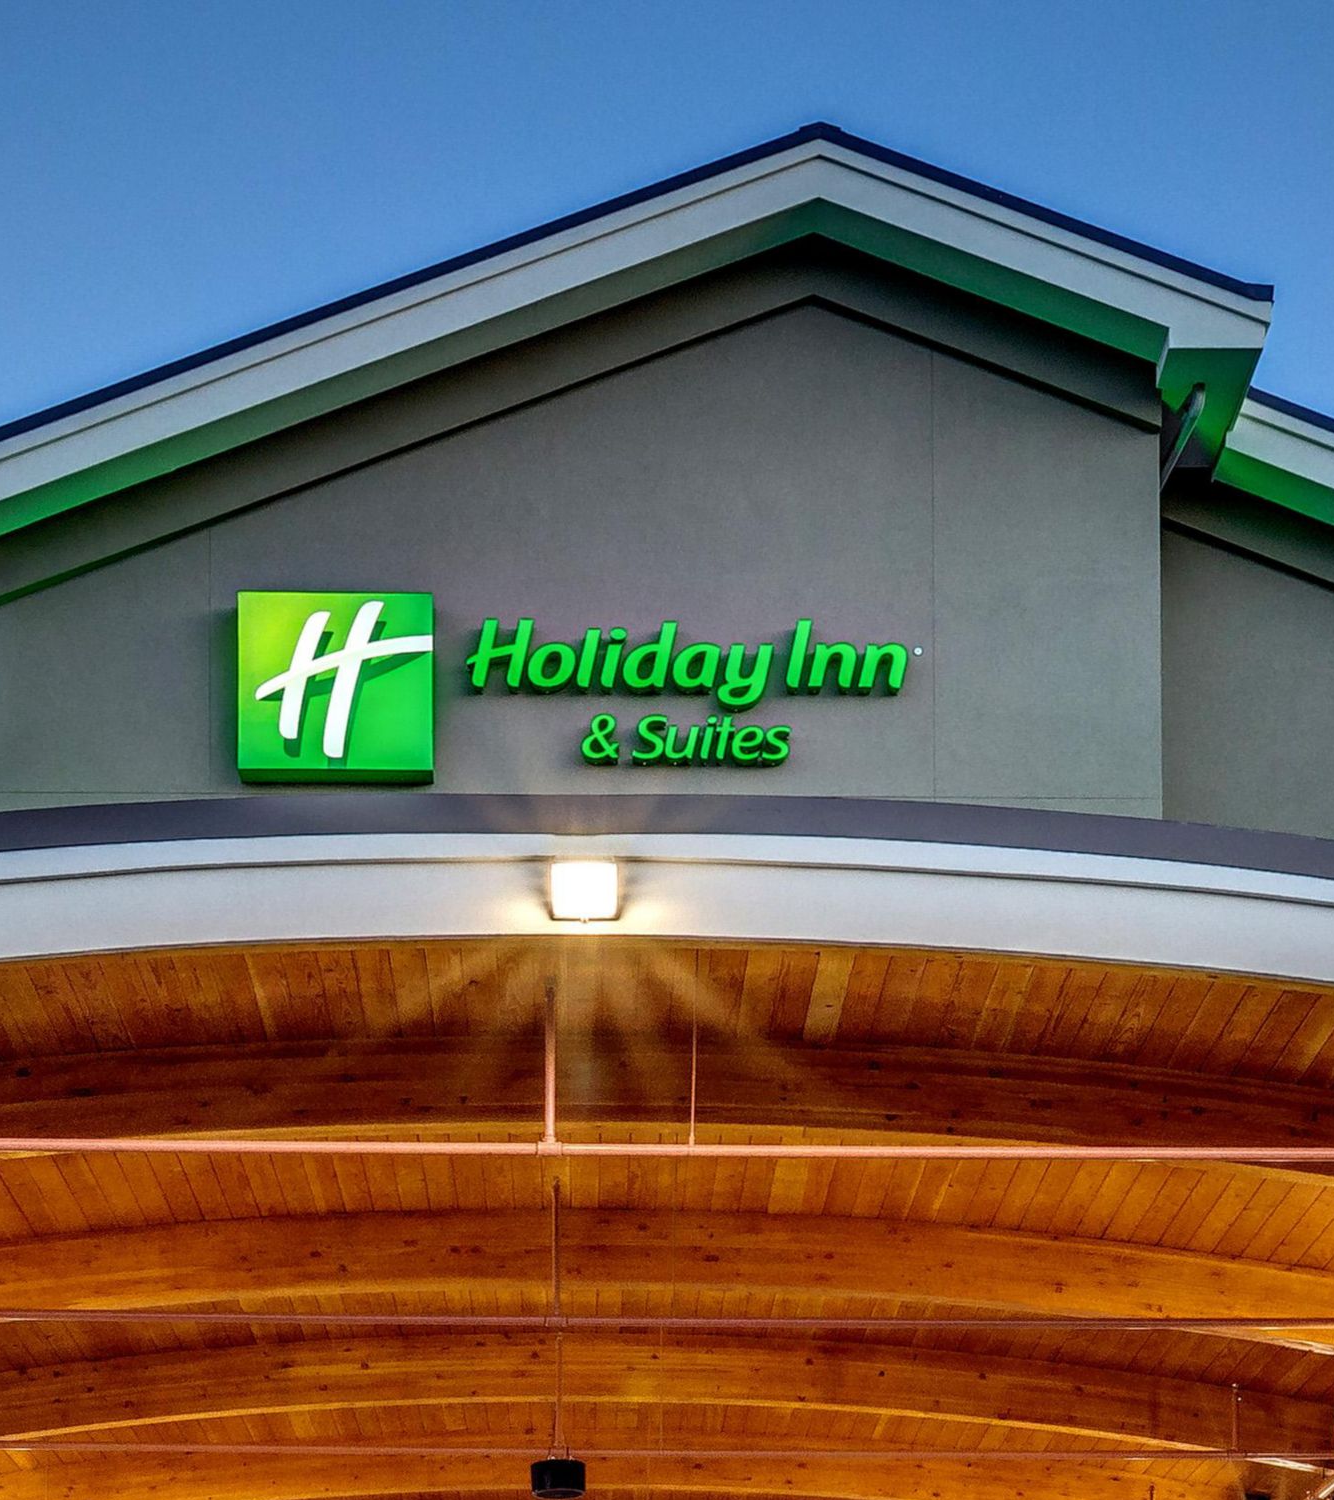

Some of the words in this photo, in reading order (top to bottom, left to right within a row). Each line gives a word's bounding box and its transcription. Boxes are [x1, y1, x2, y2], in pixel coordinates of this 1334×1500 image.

[255, 600, 433, 759] H
[467, 618, 773, 708] Holiday
[785, 618, 909, 693] Inn
[581, 713, 619, 762] &
[631, 714, 792, 763] Suites
